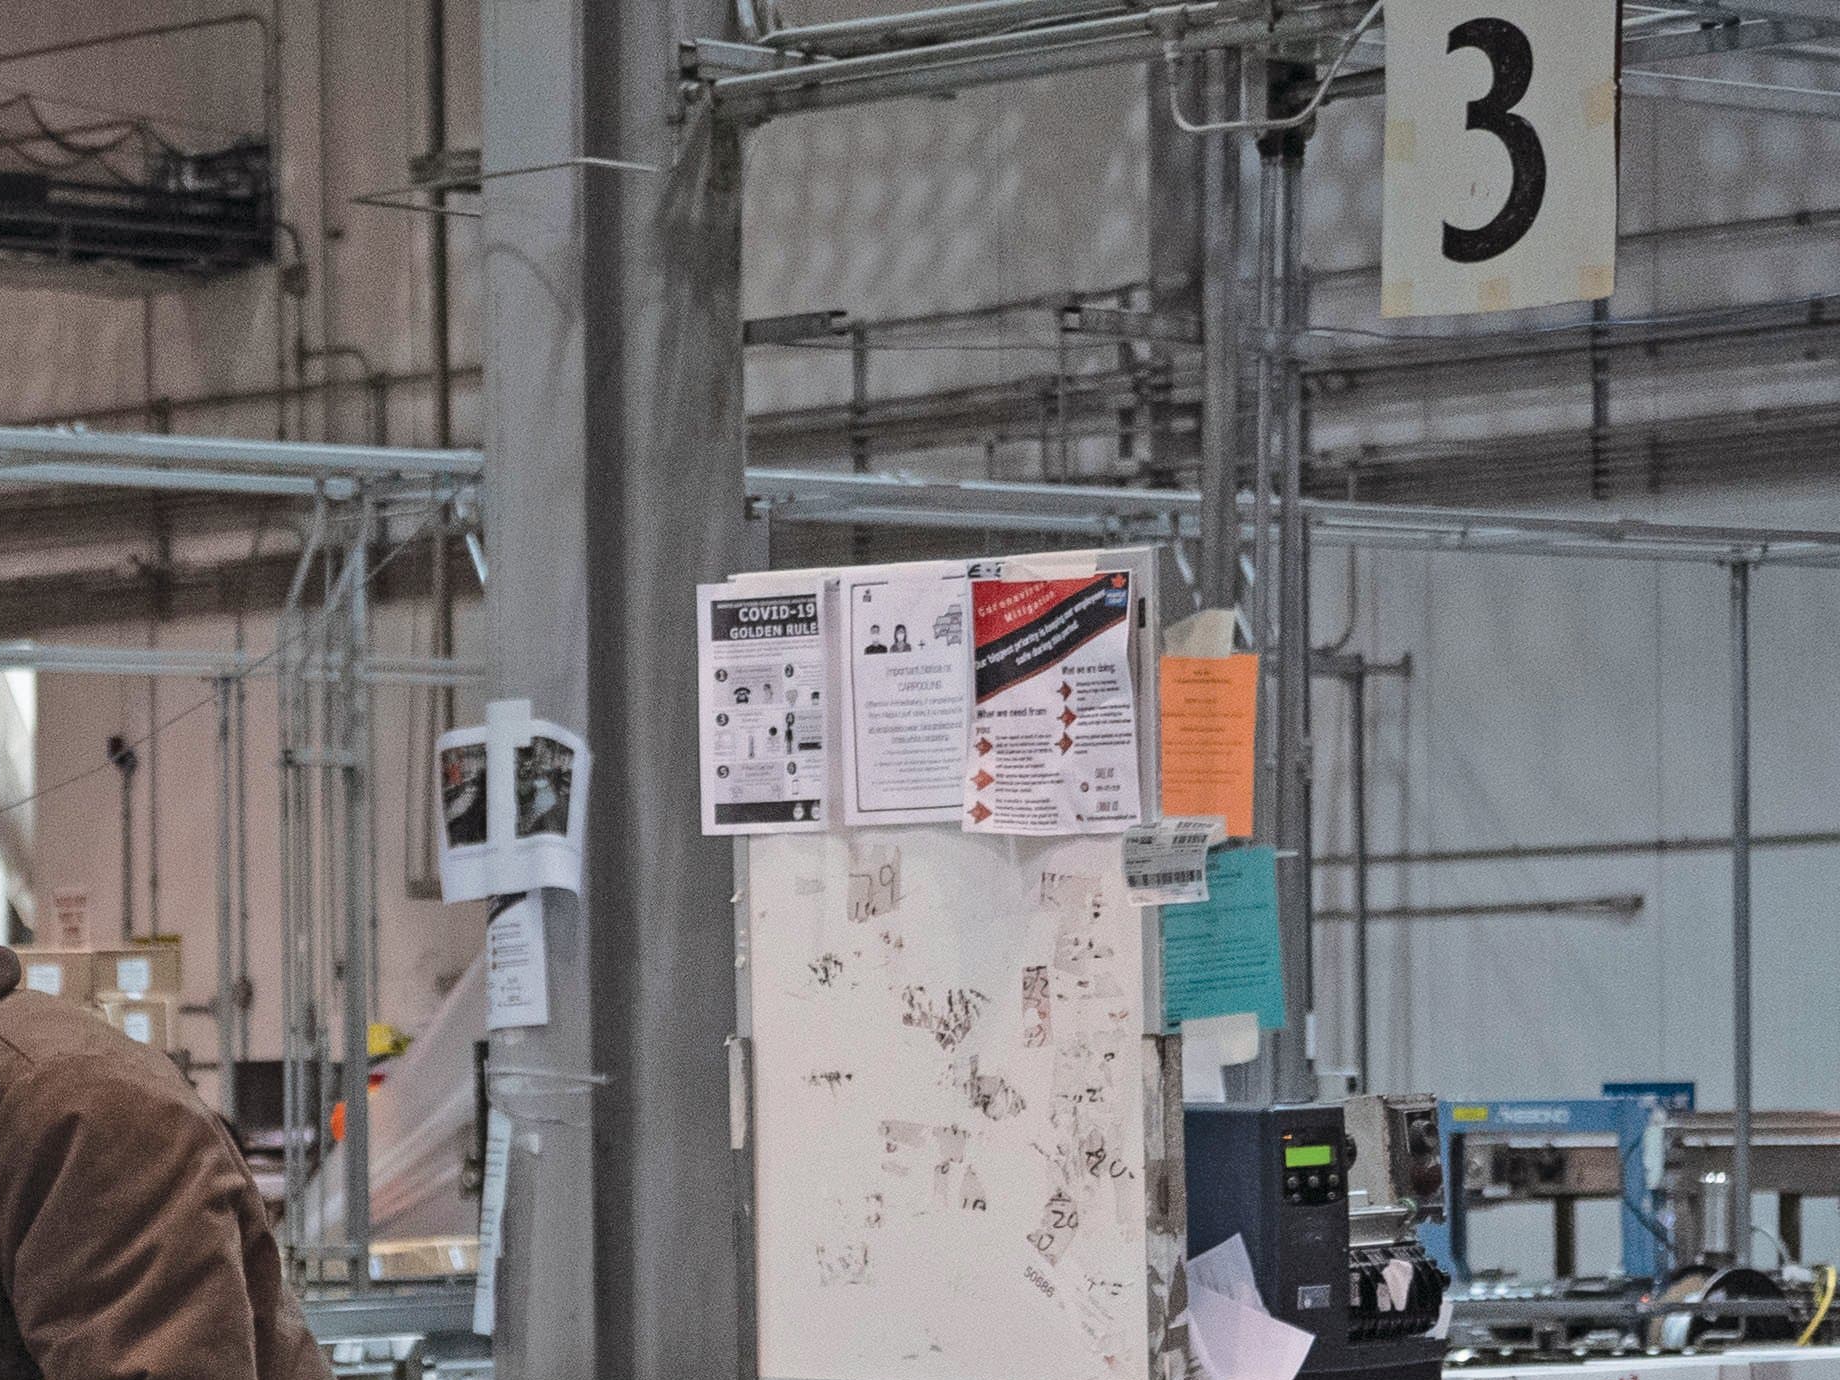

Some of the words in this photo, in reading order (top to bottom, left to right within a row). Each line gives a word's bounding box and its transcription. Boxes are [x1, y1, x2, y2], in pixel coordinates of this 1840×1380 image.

[1441, 15, 1548, 264] 3
[739, 603, 815, 622] COVID-19
[729, 626, 782, 639] GOLDEN
